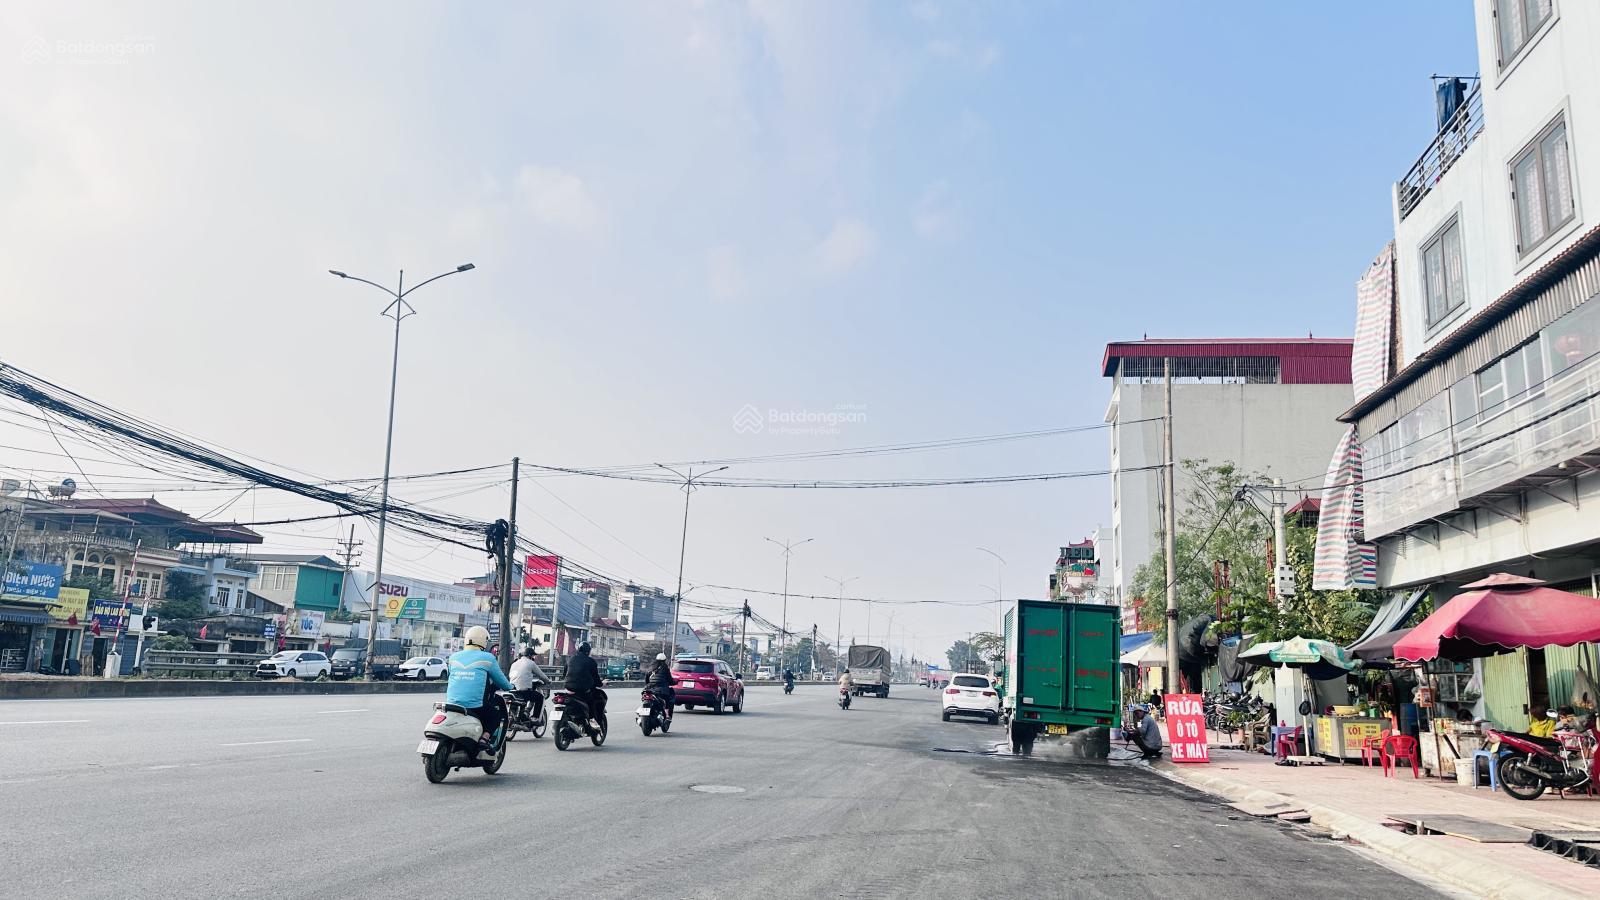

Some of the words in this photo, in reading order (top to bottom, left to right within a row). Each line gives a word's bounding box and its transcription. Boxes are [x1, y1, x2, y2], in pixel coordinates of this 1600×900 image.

[527, 567, 555, 575] ISUZU
[379, 582, 408, 597] SUZU
[1167, 696, 1203, 716] RỬA
[1176, 719, 1184, 738] Ô
[1185, 719, 1198, 738] TÔ
[1171, 742, 1185, 759] XE
[1185, 739, 1208, 759] MÁY
